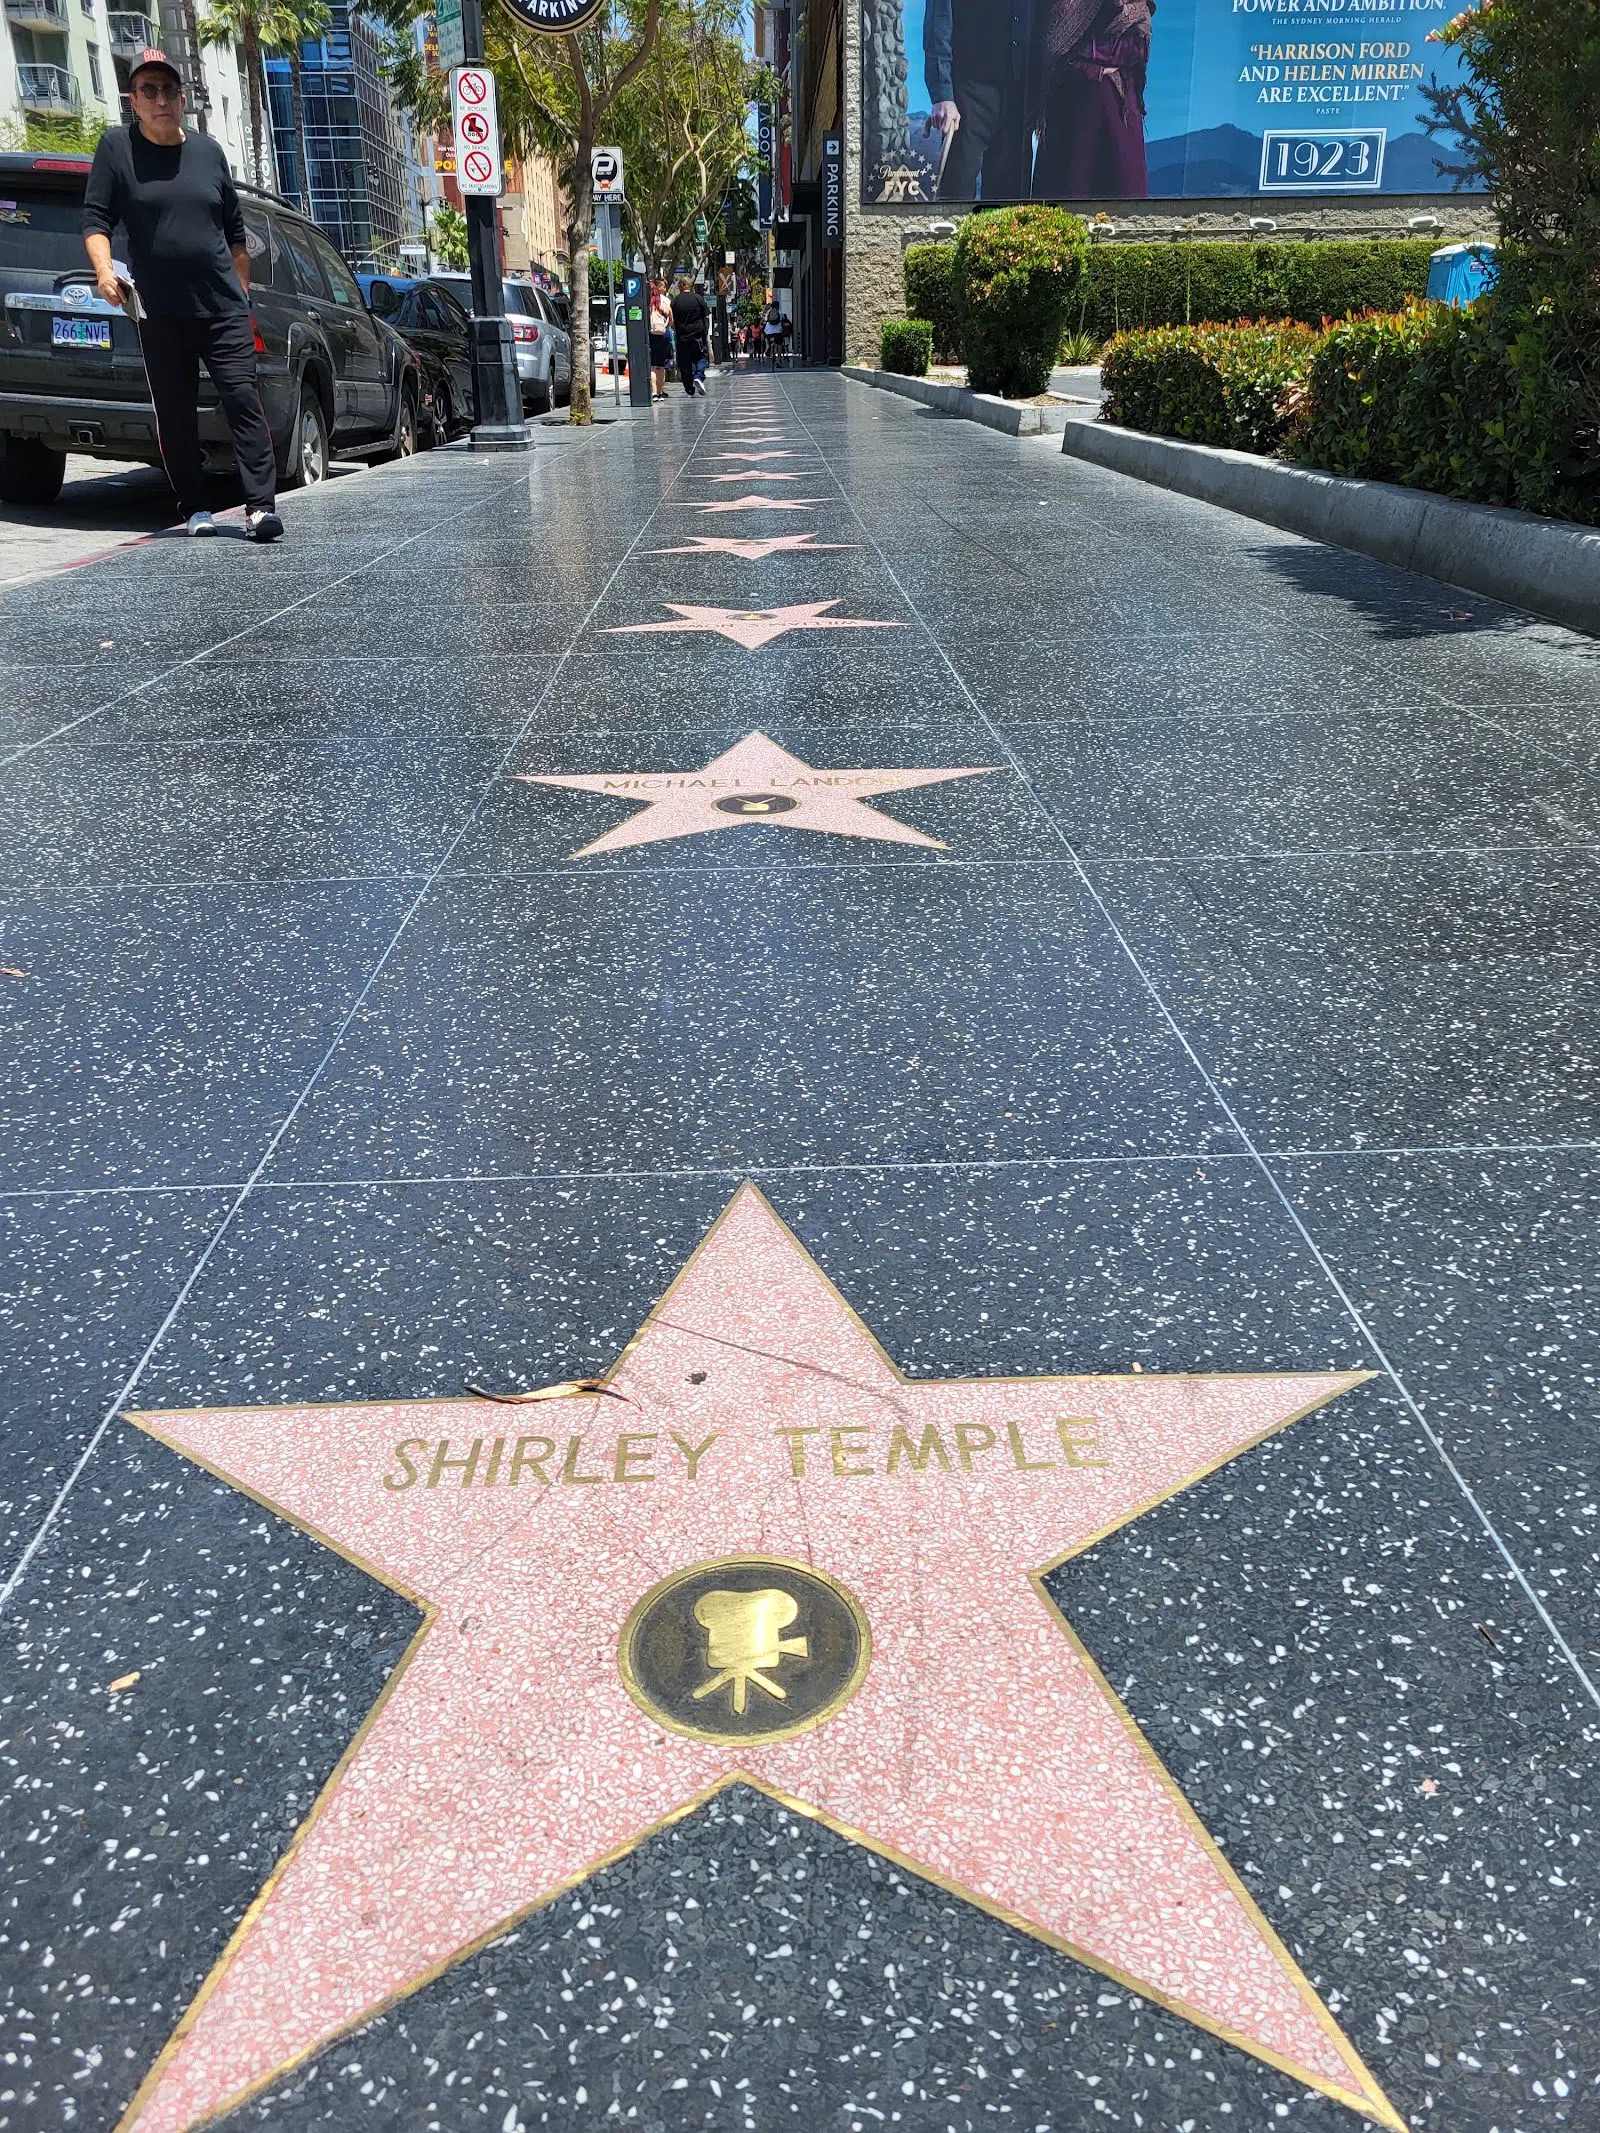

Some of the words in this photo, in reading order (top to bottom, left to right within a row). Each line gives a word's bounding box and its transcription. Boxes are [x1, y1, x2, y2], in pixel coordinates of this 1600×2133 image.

[517, 0, 588, 18] ARKIN
[1232, 0, 1300, 13] POWER
[1303, 0, 1343, 12] AND
[1348, 0, 1447, 11] AMBITION.
[1290, 17, 1322, 25] SYDNEY
[1369, 16, 1402, 24] HERALD
[1359, 42, 1411, 59] FORD
[1238, 65, 1280, 82] AND
[1283, 64, 1346, 81] HELEN
[1350, 63, 1425, 80] MIRREN
[1256, 87, 1293, 103] ARE
[1276, 141, 1370, 177] 1923
[884, 181, 920, 196] FYC
[603, 194, 622, 202] HERE
[826, 163, 839, 236] PARKING
[54, 322, 78, 340] 266
[85, 325, 108, 342] NVE
[602, 778, 755, 790] MICHAEL
[770, 775, 899, 788] LANDON
[382, 1430, 723, 1492] SHIRLEY
[773, 1416, 1110, 1477] TEMPLE
